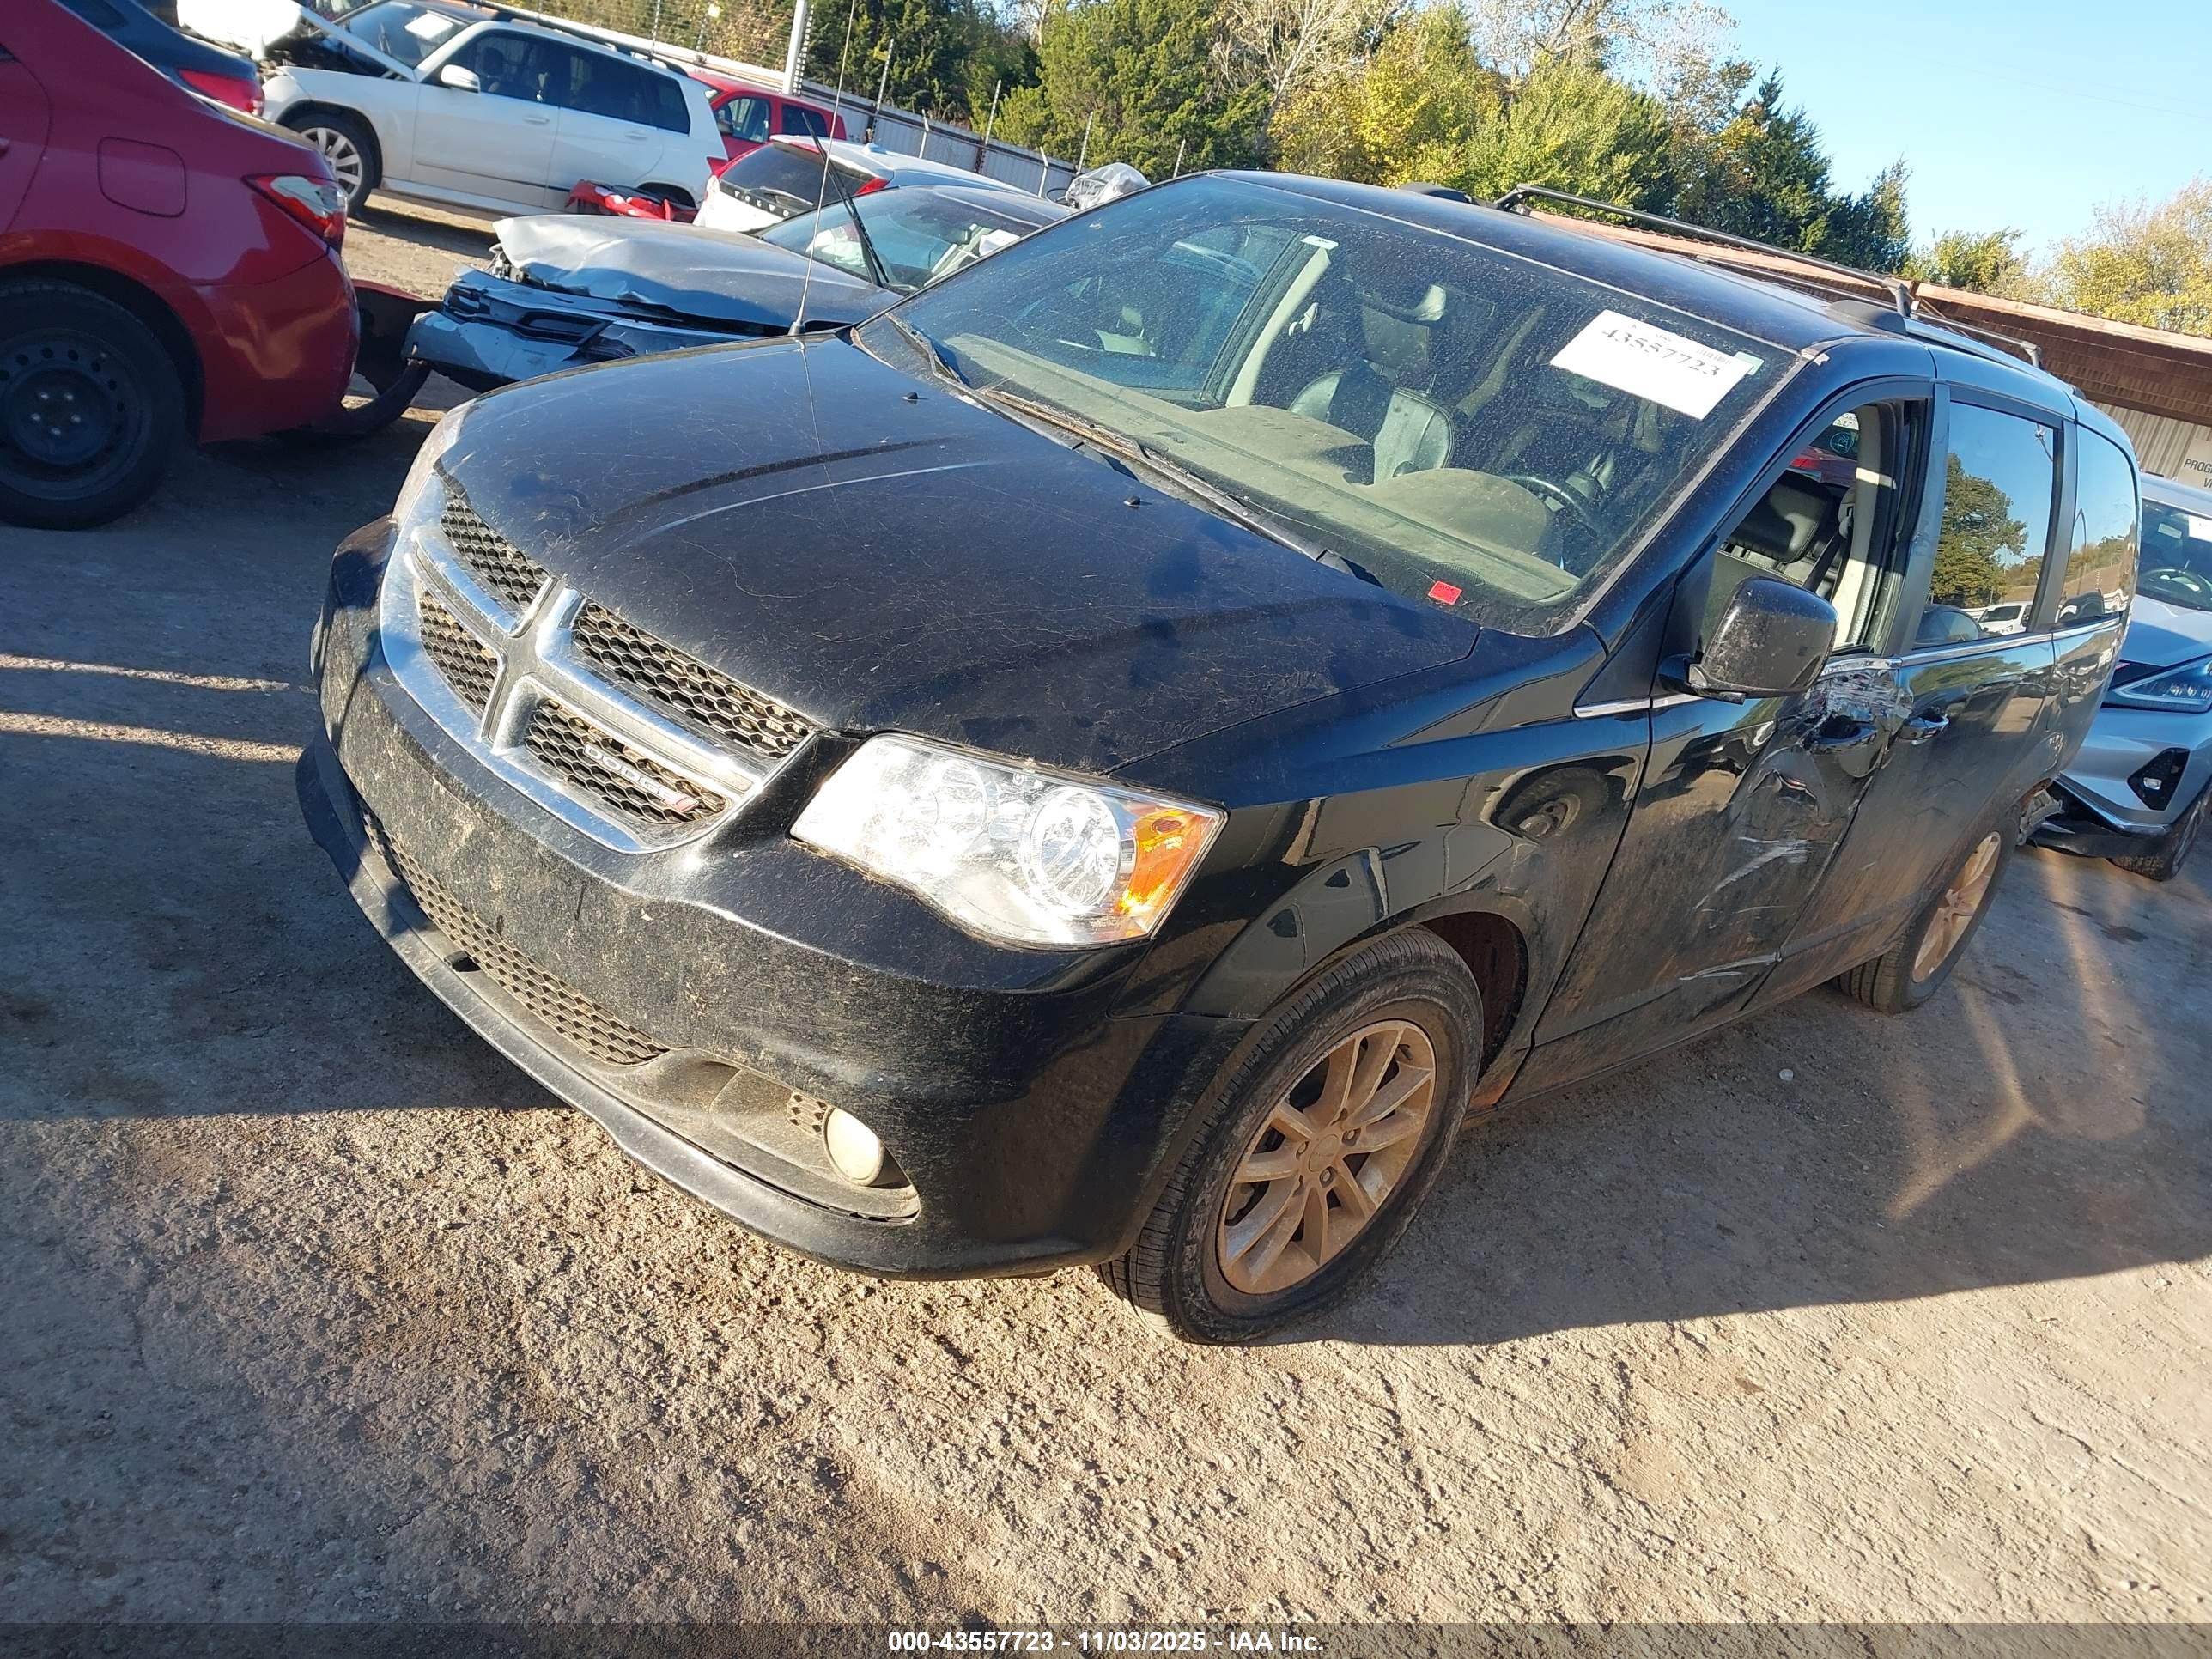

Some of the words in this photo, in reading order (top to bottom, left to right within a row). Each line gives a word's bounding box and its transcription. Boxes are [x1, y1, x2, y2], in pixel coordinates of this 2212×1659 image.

[1601, 329, 1720, 376] 43557723
[2184, 459, 2212, 474] PROG
[585, 744, 680, 802] DODGE
